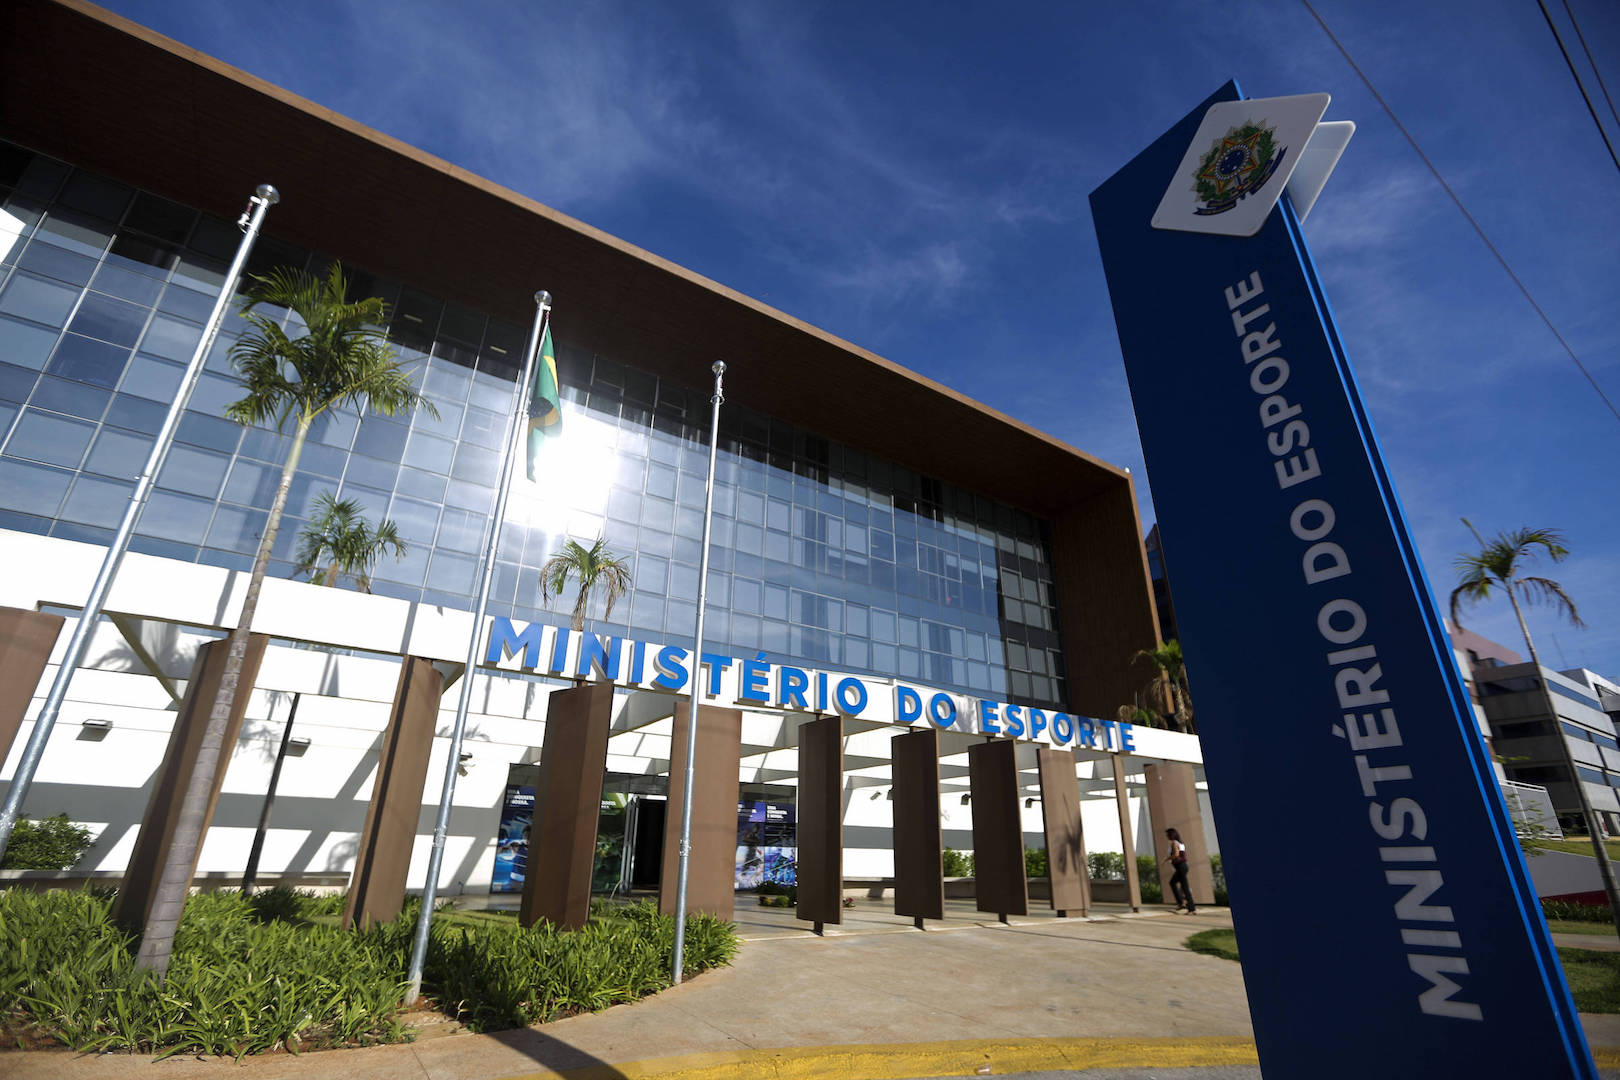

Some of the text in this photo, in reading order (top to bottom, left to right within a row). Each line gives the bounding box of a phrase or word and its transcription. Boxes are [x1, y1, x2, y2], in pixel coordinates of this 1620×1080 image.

[486, 616, 1136, 751] MINISTÉRIO DO ESPORTE
[1224, 269, 1484, 1021] MINISTÉRIO DO ESPORTE
